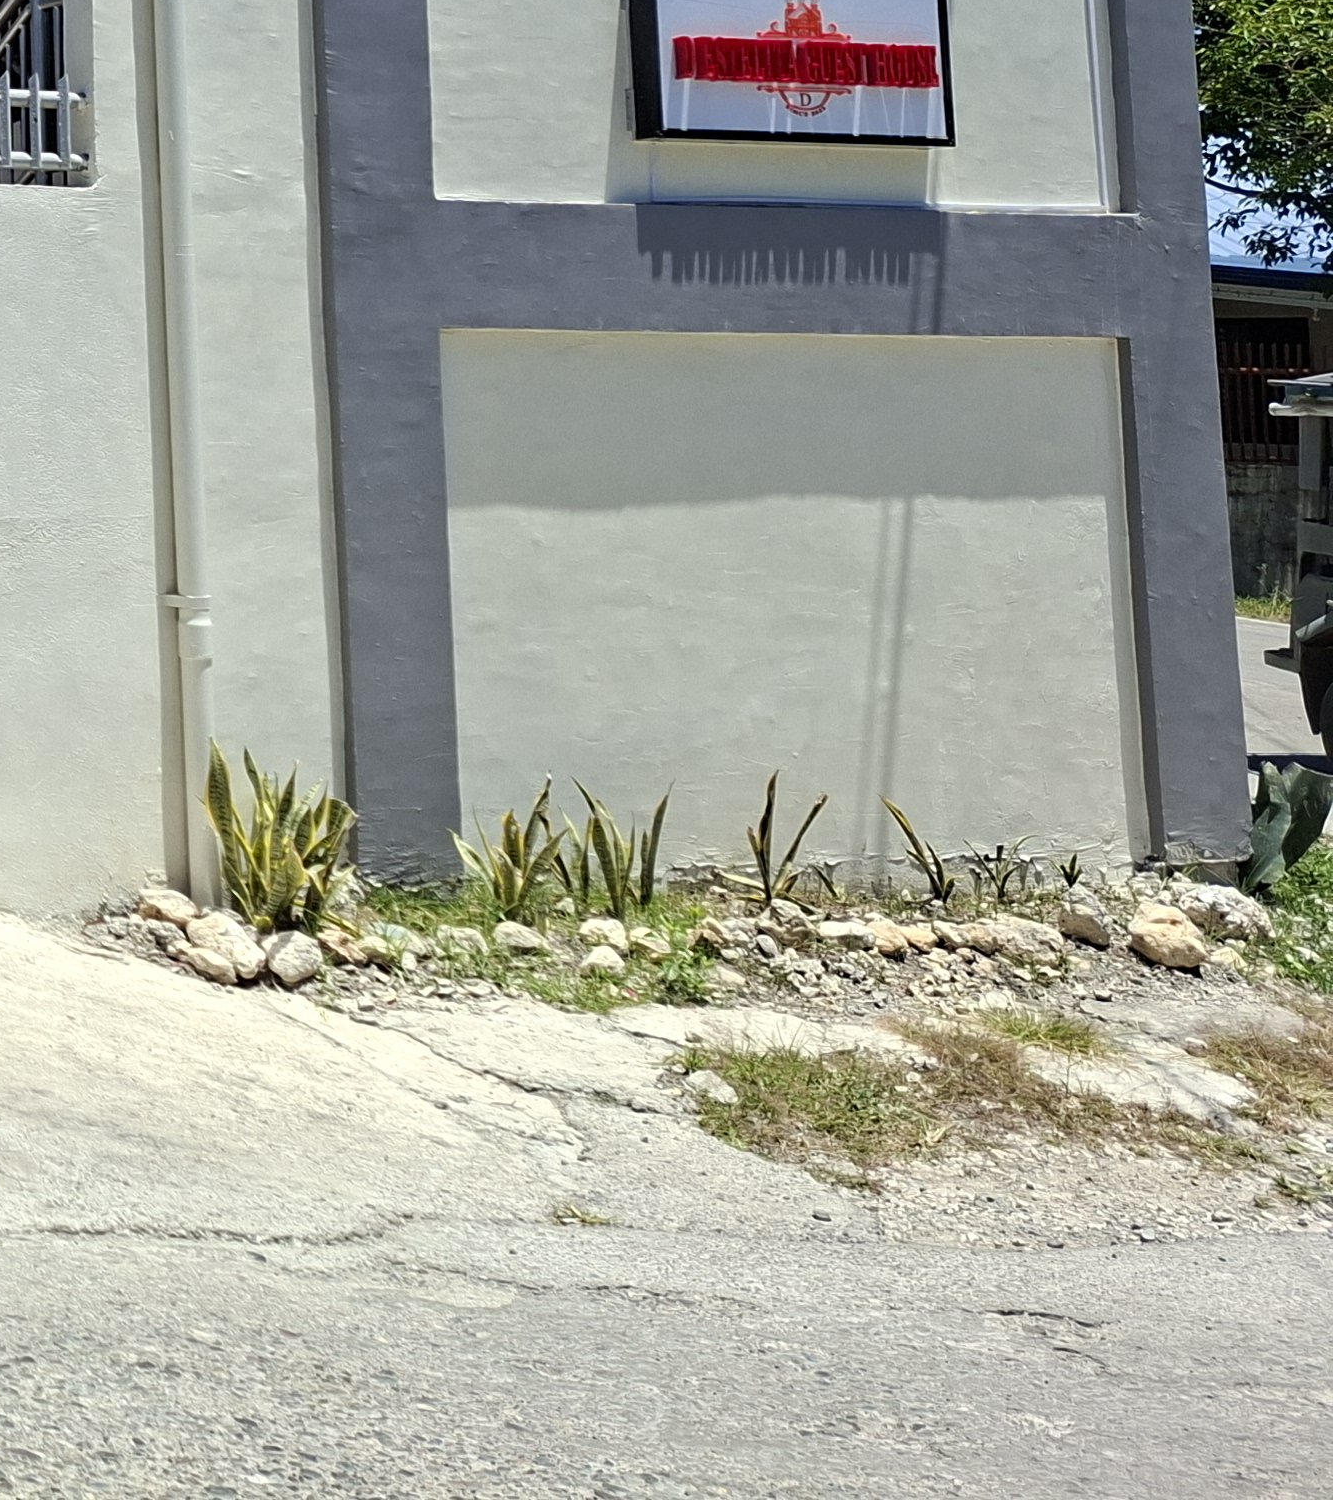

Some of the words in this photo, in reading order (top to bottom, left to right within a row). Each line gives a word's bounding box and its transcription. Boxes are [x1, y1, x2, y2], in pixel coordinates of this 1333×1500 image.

[798, 41, 868, 86] GUEST
[867, 44, 939, 88] HOUSE
[799, 92, 812, 107] D
